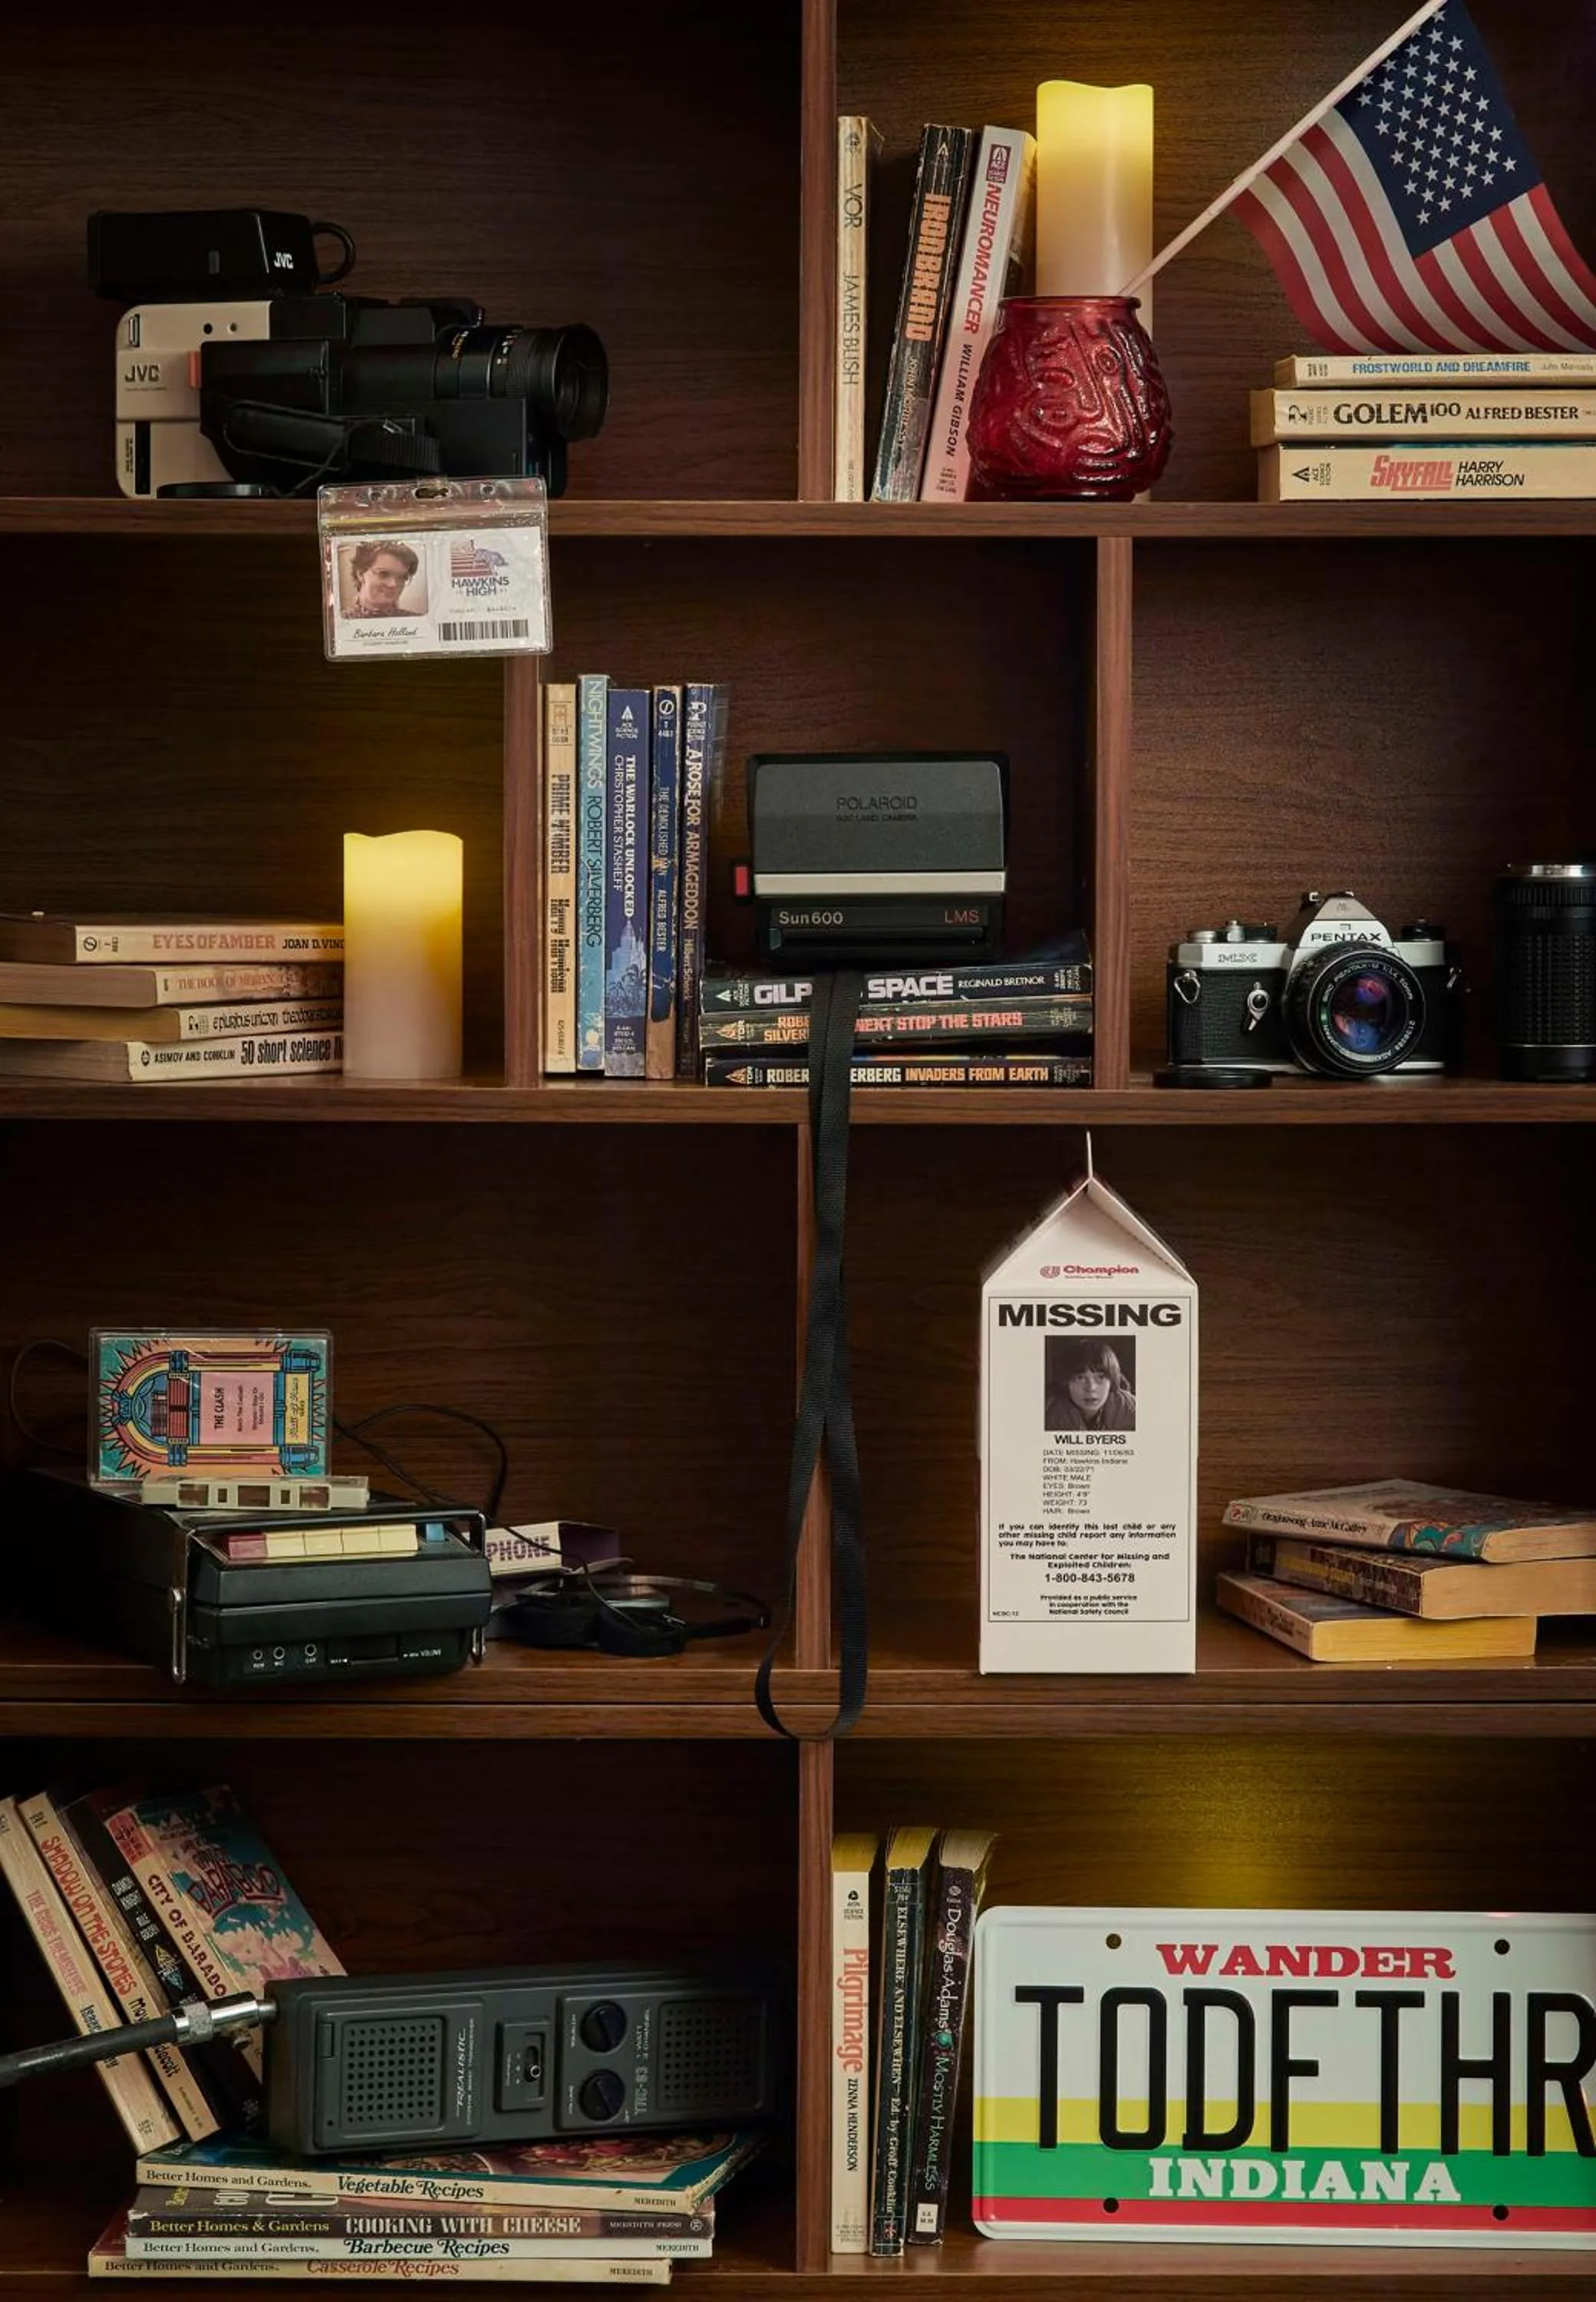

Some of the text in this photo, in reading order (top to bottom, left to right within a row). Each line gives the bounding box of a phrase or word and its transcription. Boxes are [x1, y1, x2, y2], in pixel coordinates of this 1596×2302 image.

[273, 252, 294, 269] JVC
[964, 182, 1001, 335] NEUROMANCER
[842, 183, 863, 385] VOR JAMES BLISH
[125, 365, 160, 382] JVC
[955, 343, 973, 403] WILLIAM
[1352, 361, 1532, 374] FROSTWORLD AND DREAMFIRE
[1465, 407, 1522, 420] ALFRED
[1524, 406, 1579, 420] BESTER
[945, 406, 964, 457] GIBSON
[1458, 460, 1504, 473] HARRY
[1456, 473, 1525, 486] HARRISON
[451, 577, 509, 589] HAWKINS
[466, 586, 496, 596] HIGH
[684, 761, 703, 801] ROSE
[684, 799, 701, 826] FOR
[836, 796, 918, 810] POLAROID
[585, 680, 602, 948] NIGHTWINGS ROBERT SILVERBERG
[613, 754, 624, 892] CHRISTOPHER STASHEFF
[624, 754, 636, 918] THE WARLOCK UNLOCKED
[683, 831, 701, 930] ARMAGEDDON
[944, 909, 980, 923] LMS
[153, 934, 309, 950] EYES OF AMBER JOAN
[1311, 932, 1381, 942] PENTAX
[1218, 952, 1256, 963] MX
[867, 975, 954, 999] SPACE
[958, 978, 1002, 989] REGINALD
[1003, 975, 1046, 987] BRETNOR
[854, 1012, 1024, 1032] NEXT STOP THE STARS
[241, 1040, 255, 1065] 50
[258, 1038, 287, 1064] short
[291, 1037, 331, 1061] science
[767, 1067, 1049, 1083] ROBER INVADERS FROM EARTH
[1063, 1265, 1139, 1276] Champion
[998, 1304, 1182, 1327] MISSING
[214, 1387, 224, 1430] THE CLASH
[1054, 1434, 1127, 1445] WILL BYERS
[1023, 1532, 1054, 1540] missing
[1080, 1532, 1106, 1540] report
[1048, 1523, 1080, 1532] identify
[486, 1535, 551, 1562] PHONE
[1116, 1553, 1150, 1562] Missing
[1047, 1561, 1090, 1569] Exploited
[1044, 1573, 1136, 1583] 1-800-843-5678
[41, 1835, 87, 1897] SHADOW
[71, 1892, 96, 1917] ON
[84, 1913, 110, 1943] THE
[147, 1873, 173, 1905] CITY
[168, 1908, 187, 1929] OF
[182, 1931, 229, 1998] BARABO
[96, 1941, 137, 1996] STONES
[1155, 1943, 1457, 1980] WANDER
[836, 1948, 869, 2172] Pilgrimage ZENNA HENDERSON
[1014, 1984, 1596, 2159] TODFTHR
[147, 2169, 183, 2182] Better
[186, 2172, 228, 2185] Homes
[230, 2174, 255, 2186] and
[336, 2175, 414, 2194] Vegetable
[417, 2180, 484, 2200] Recipes
[634, 2197, 677, 2207] MEREDITH
[1147, 2157, 1462, 2202] INDIANA
[150, 2216, 655, 2234] Better Homes & Gardens COOKING WITH CHEESE MEREDITH
[143, 2242, 182, 2253] Better
[185, 2242, 231, 2253] Homes
[234, 2242, 257, 2253] and
[343, 2238, 434, 2254] Barbecue
[437, 2238, 510, 2258] Recipes
[655, 2243, 700, 2253] MEREDITH
[104, 2261, 142, 2271] Better
[146, 2261, 191, 2271] Homes
[194, 2261, 219, 2271] and
[306, 2258, 387, 2274] Casserole
[389, 2260, 460, 2278] Recipes
[609, 2267, 653, 2277] MEREDITH
